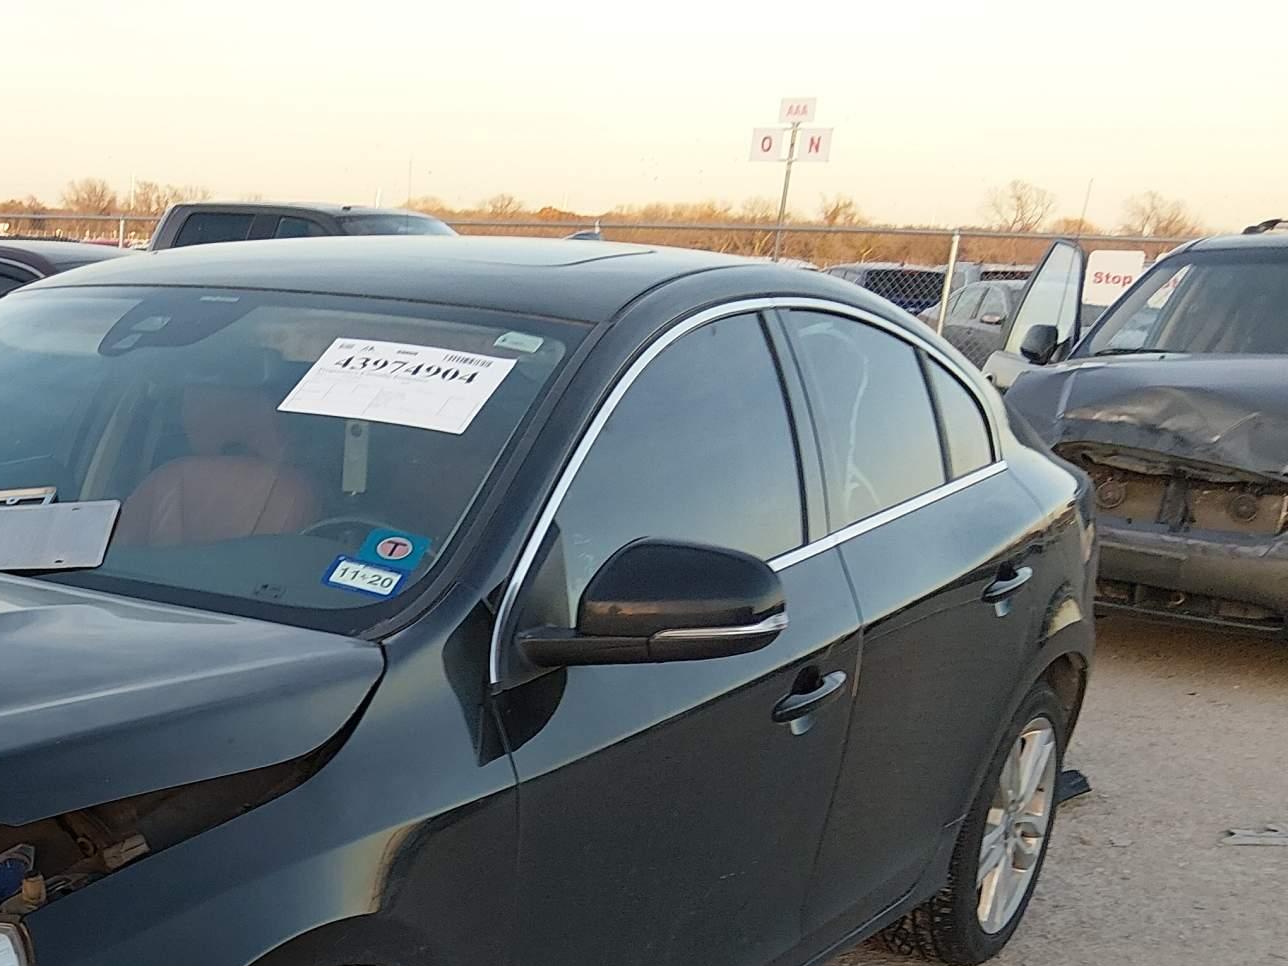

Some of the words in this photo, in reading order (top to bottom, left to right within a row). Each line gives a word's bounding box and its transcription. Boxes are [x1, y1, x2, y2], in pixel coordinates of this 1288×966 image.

[786, 104, 808, 116] AAA
[808, 136, 822, 154] N
[1093, 272, 1133, 287] Stop
[334, 354, 480, 385] 43974904
[387, 540, 408, 557] T
